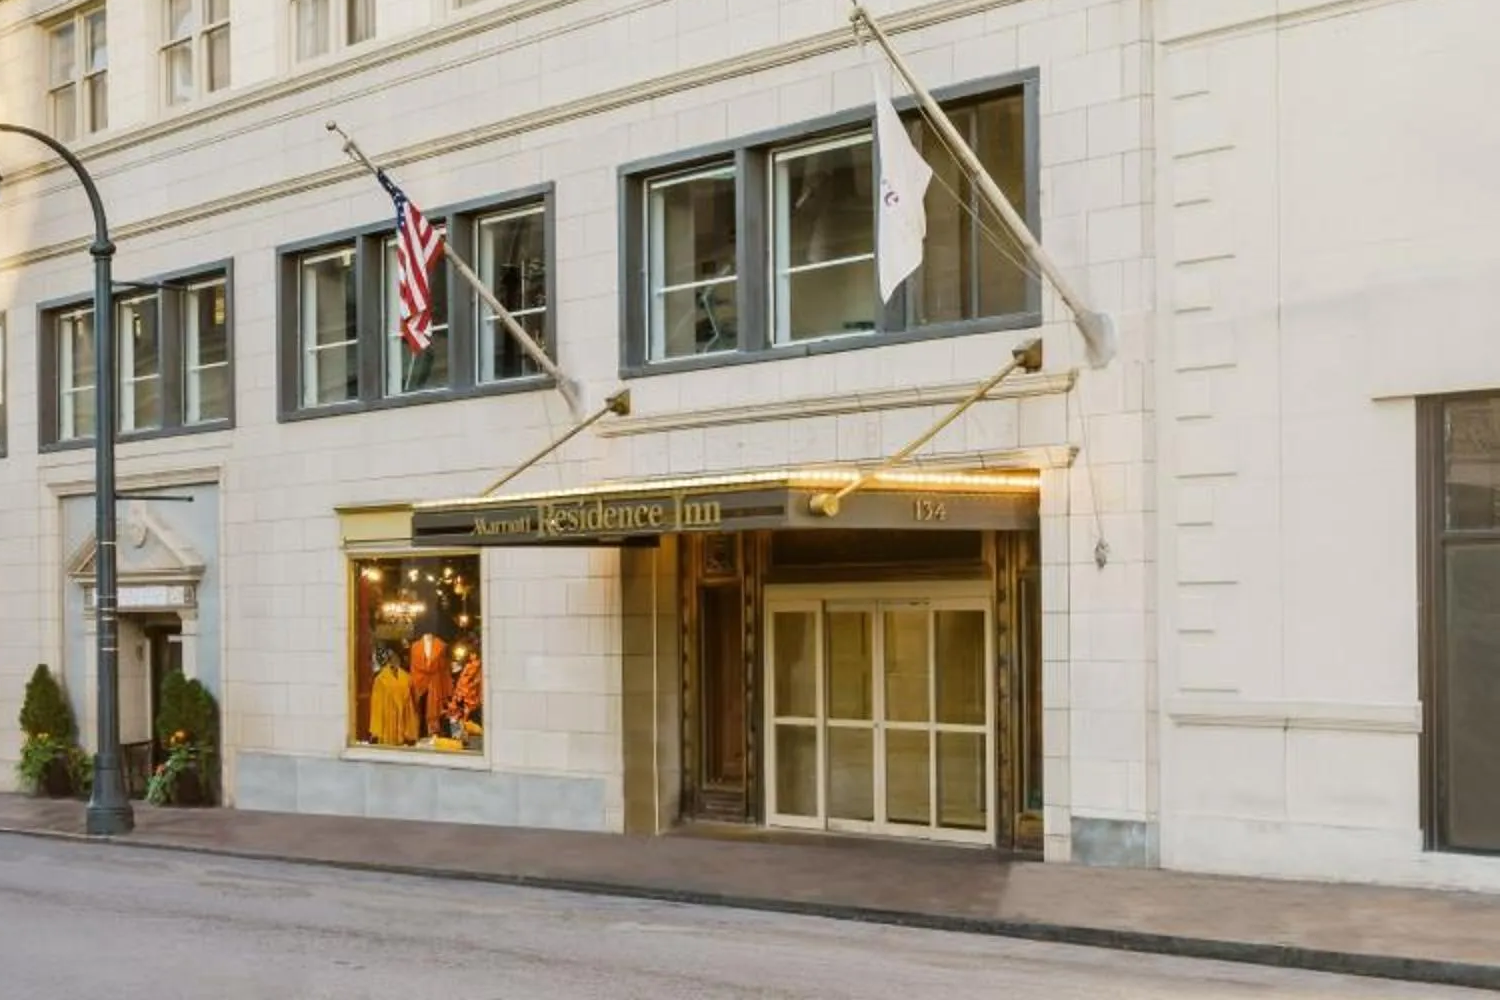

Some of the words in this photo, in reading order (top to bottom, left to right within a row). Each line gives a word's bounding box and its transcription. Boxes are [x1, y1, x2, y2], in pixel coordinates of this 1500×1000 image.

[471, 515, 530, 537] Marriott
[537, 498, 662, 537] Residence
[672, 494, 722, 531] Inn
[915, 500, 946, 521] 134
